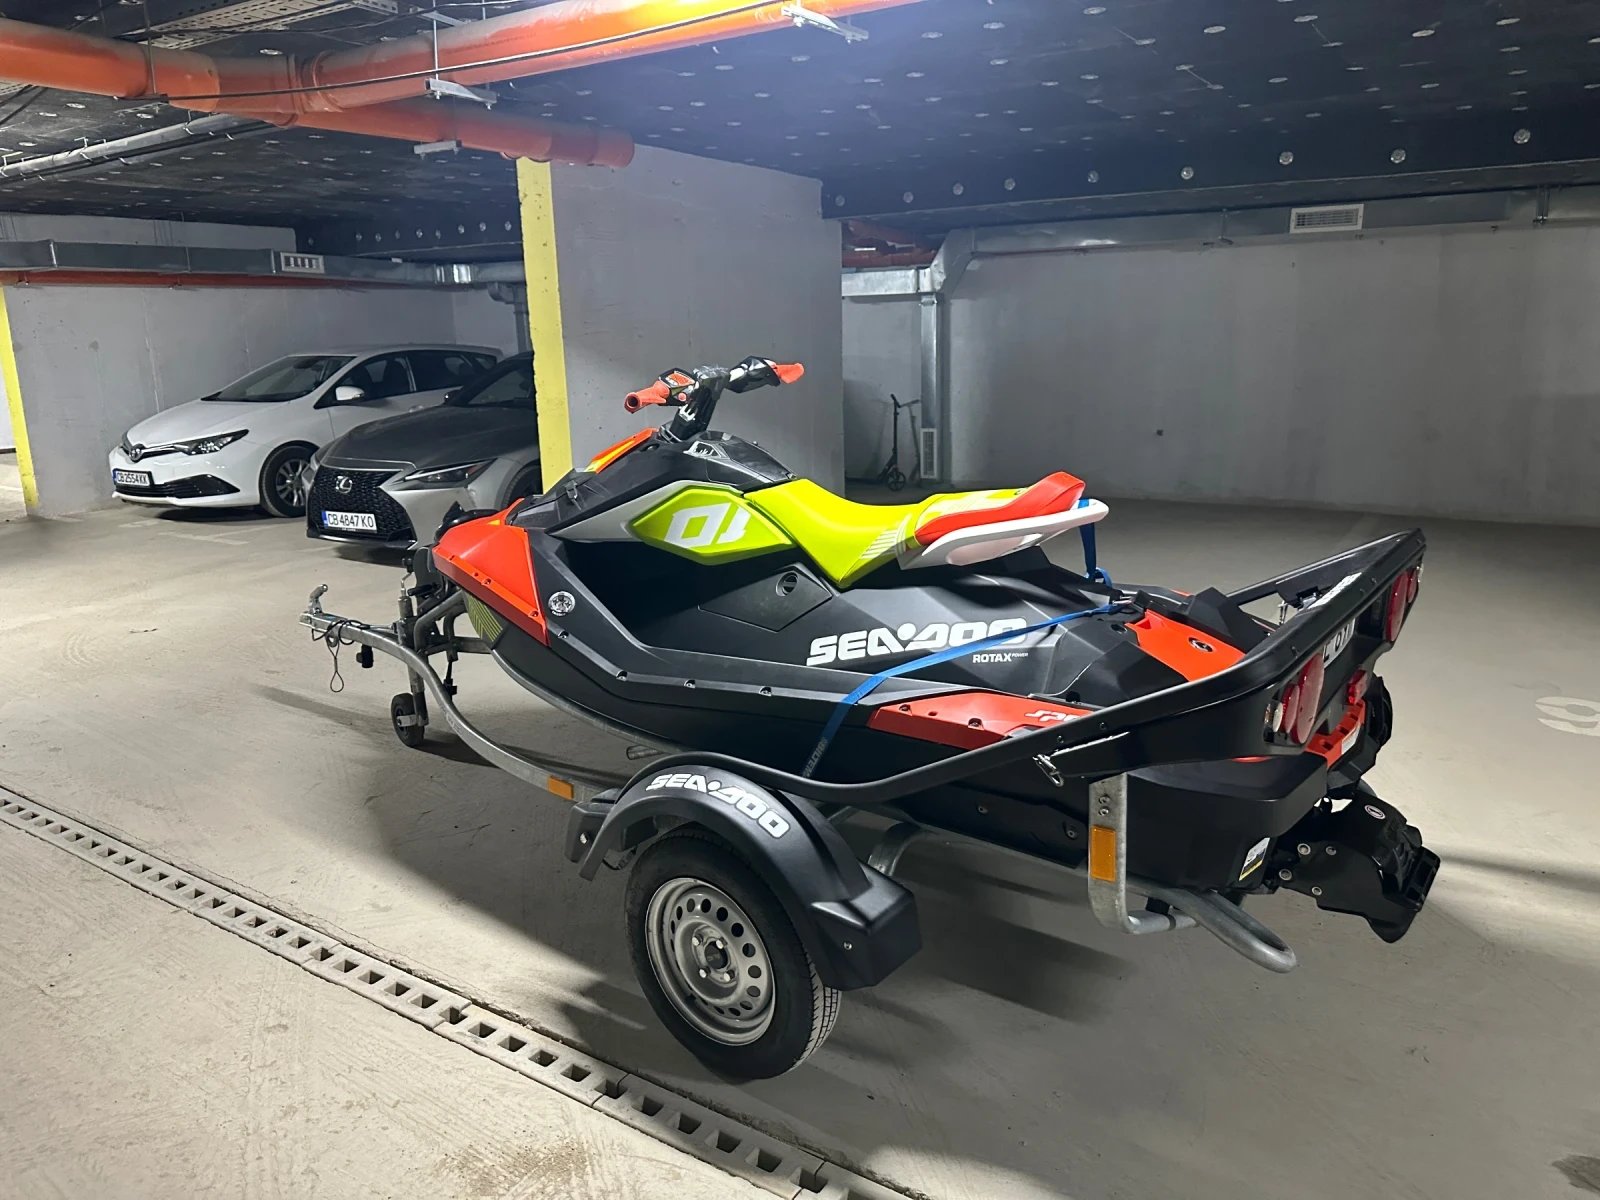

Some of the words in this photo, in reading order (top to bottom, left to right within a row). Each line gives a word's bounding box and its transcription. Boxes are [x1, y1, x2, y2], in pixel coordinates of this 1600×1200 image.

[327, 513, 339, 526] CB
[340, 514, 360, 527] 4847
[361, 515, 374, 528] KO
[972, 653, 1012, 663] ROTAX
